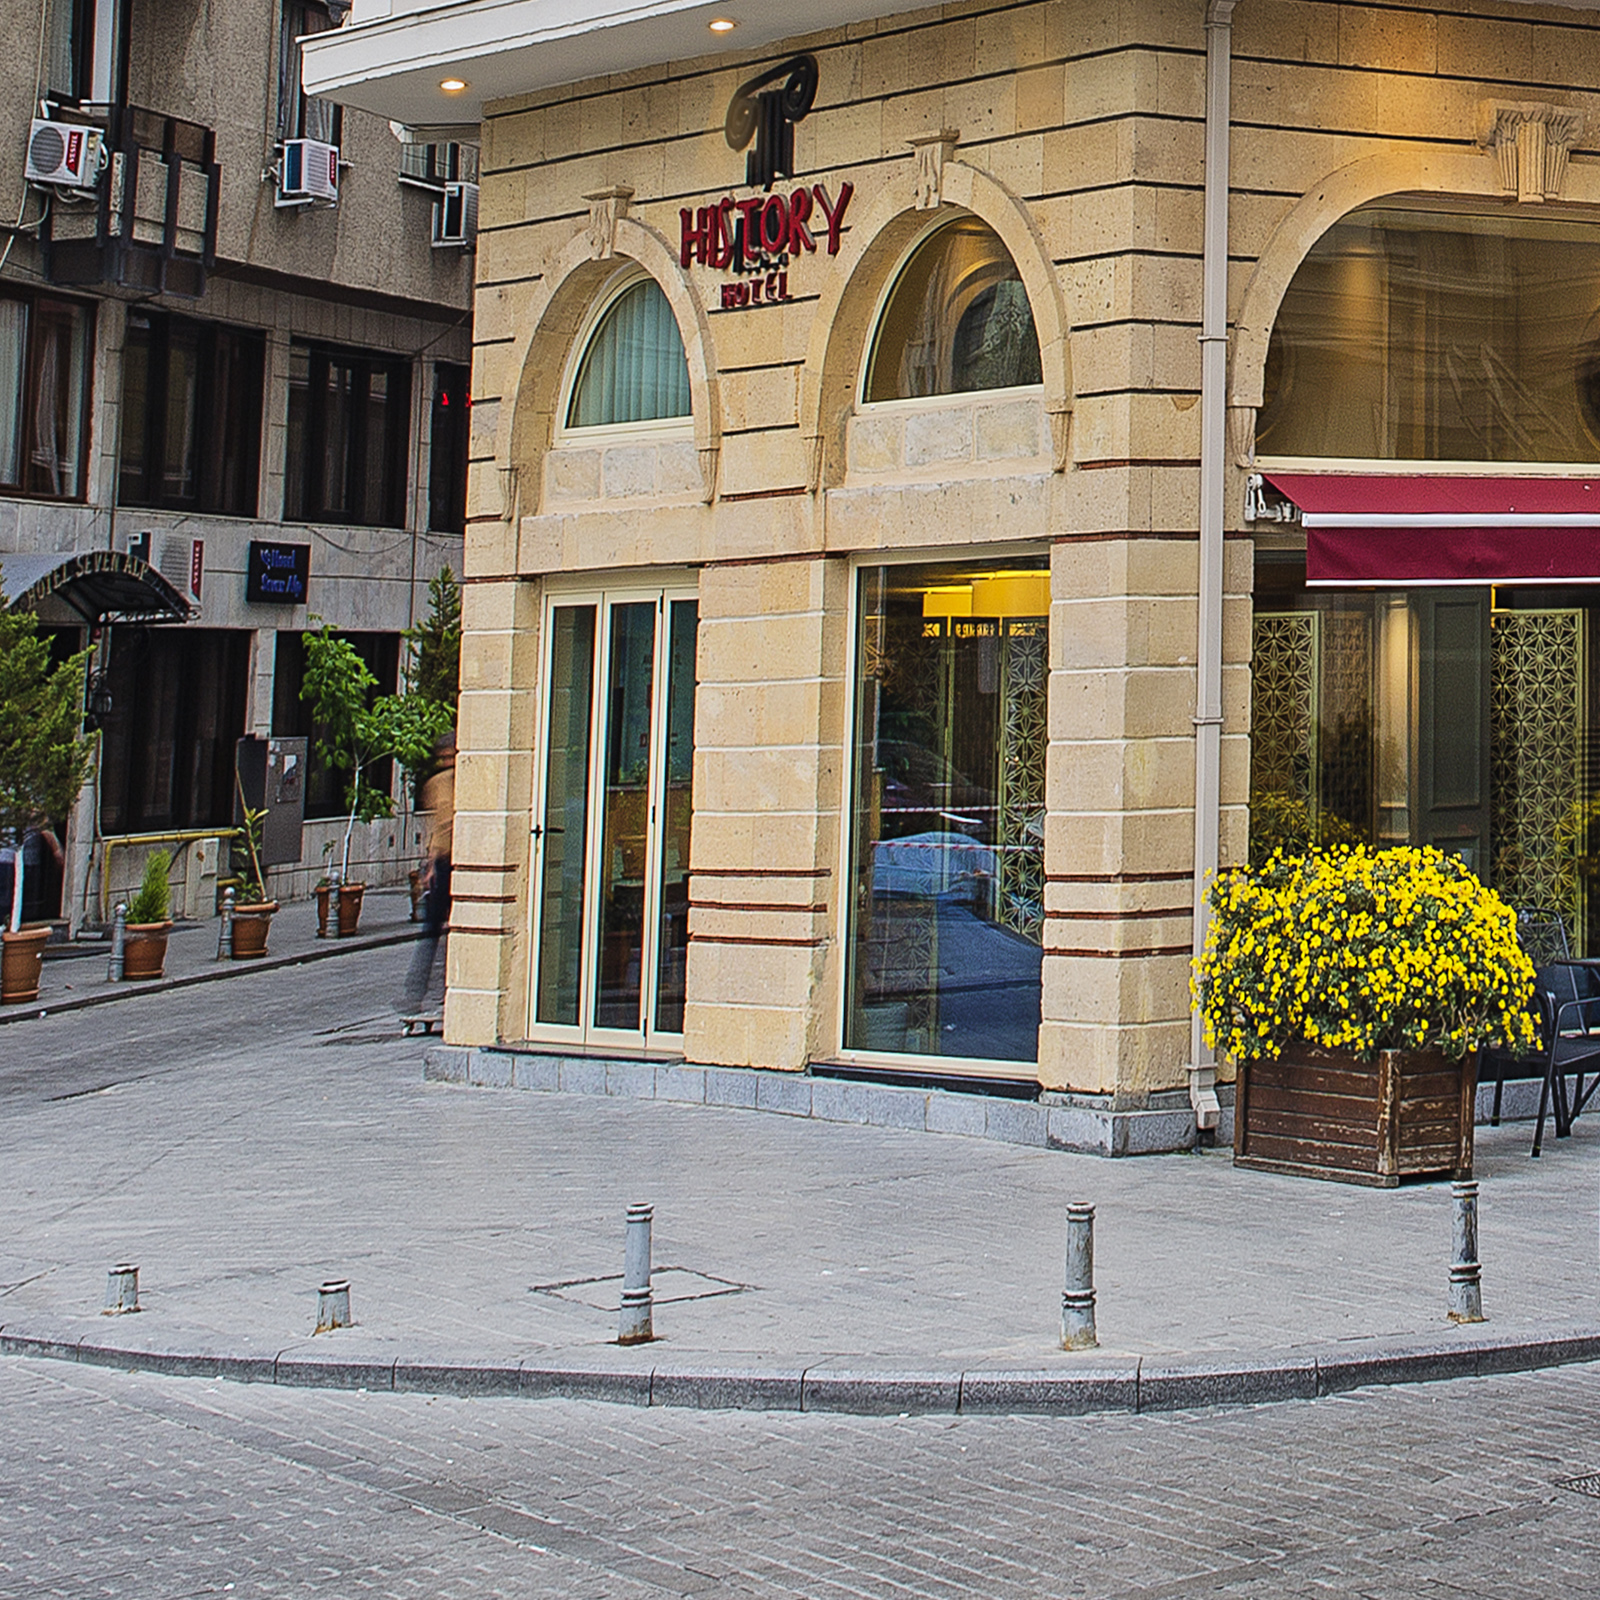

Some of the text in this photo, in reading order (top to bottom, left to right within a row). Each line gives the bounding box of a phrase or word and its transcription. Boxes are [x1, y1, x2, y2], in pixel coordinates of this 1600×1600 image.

[68, 133, 79, 163] VESTEL
[679, 181, 854, 270] HISTORY
[720, 271, 794, 308] HOTEL
[27, 552, 149, 609] HOTEL SEVEN ALP
